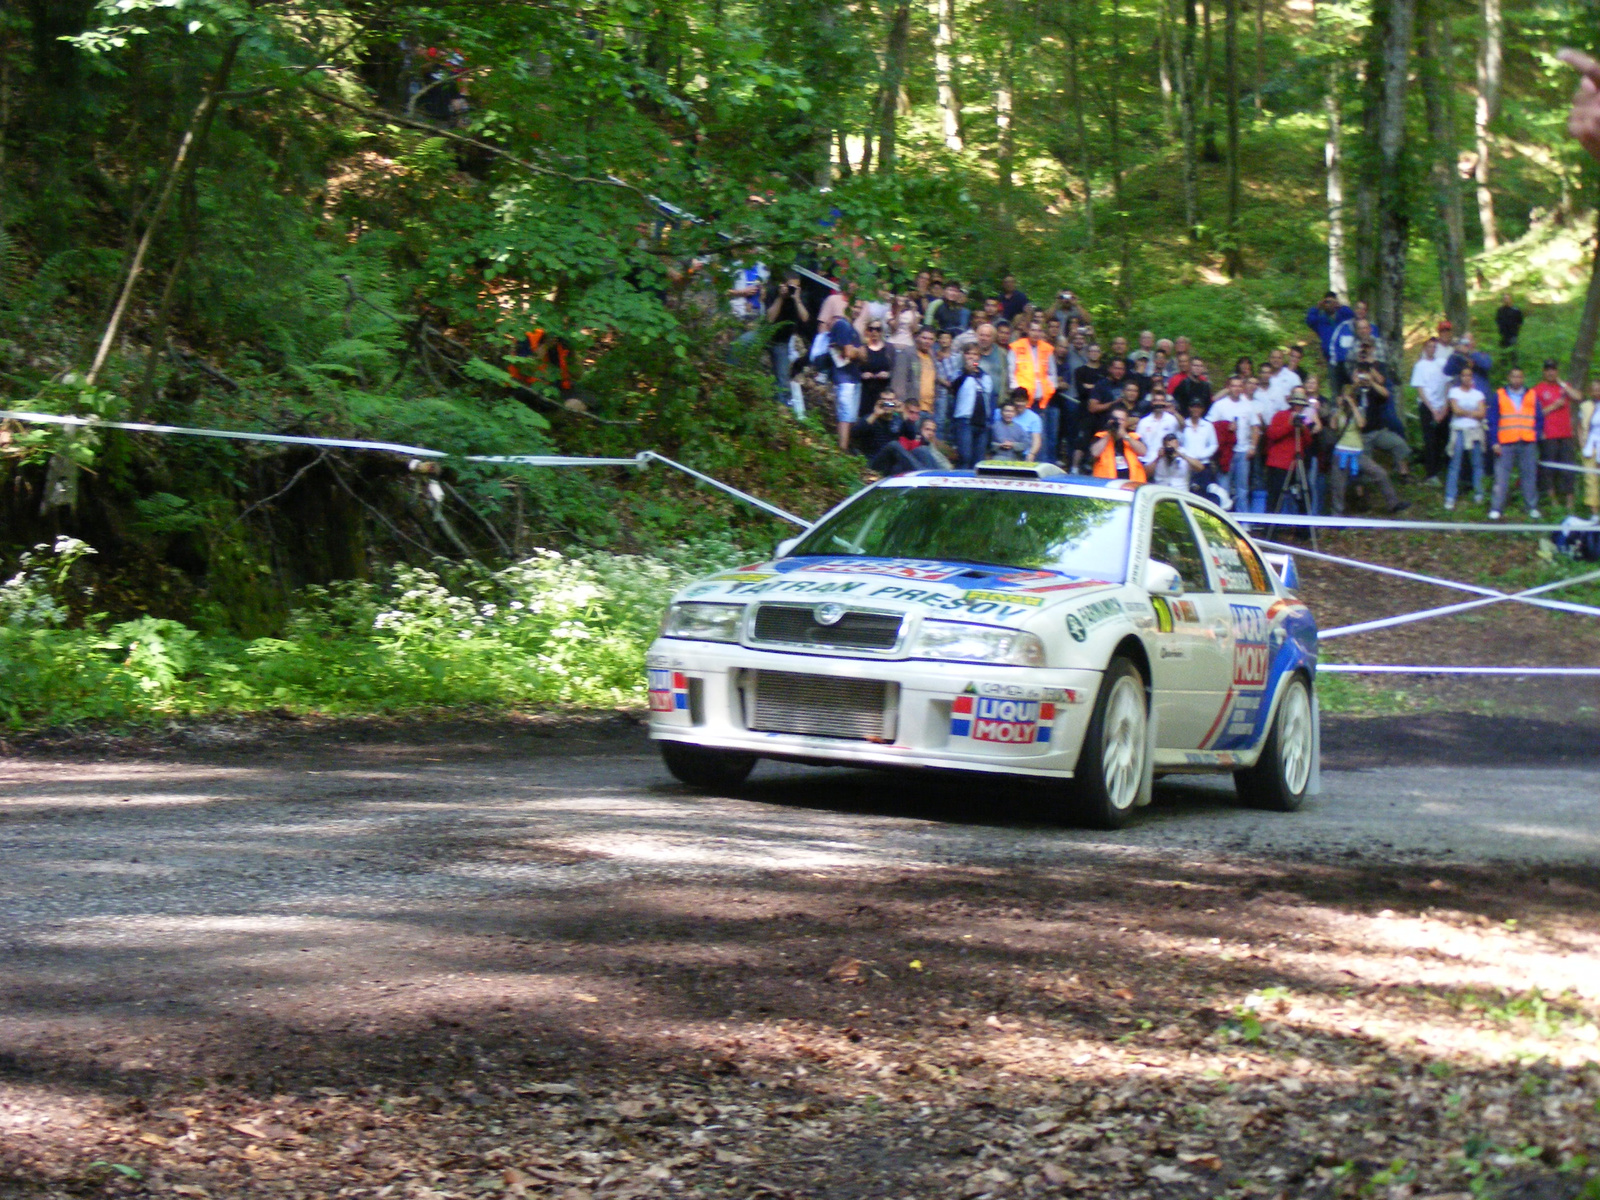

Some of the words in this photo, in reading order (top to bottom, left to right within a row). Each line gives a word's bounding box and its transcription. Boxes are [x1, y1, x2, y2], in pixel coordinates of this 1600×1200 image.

[725, 581, 867, 595] TATRAN
[1231, 605, 1268, 641] LIQUI
[1234, 646, 1268, 681] MOLY
[977, 698, 1039, 722] LIQUI
[975, 720, 1036, 742] MOLY
